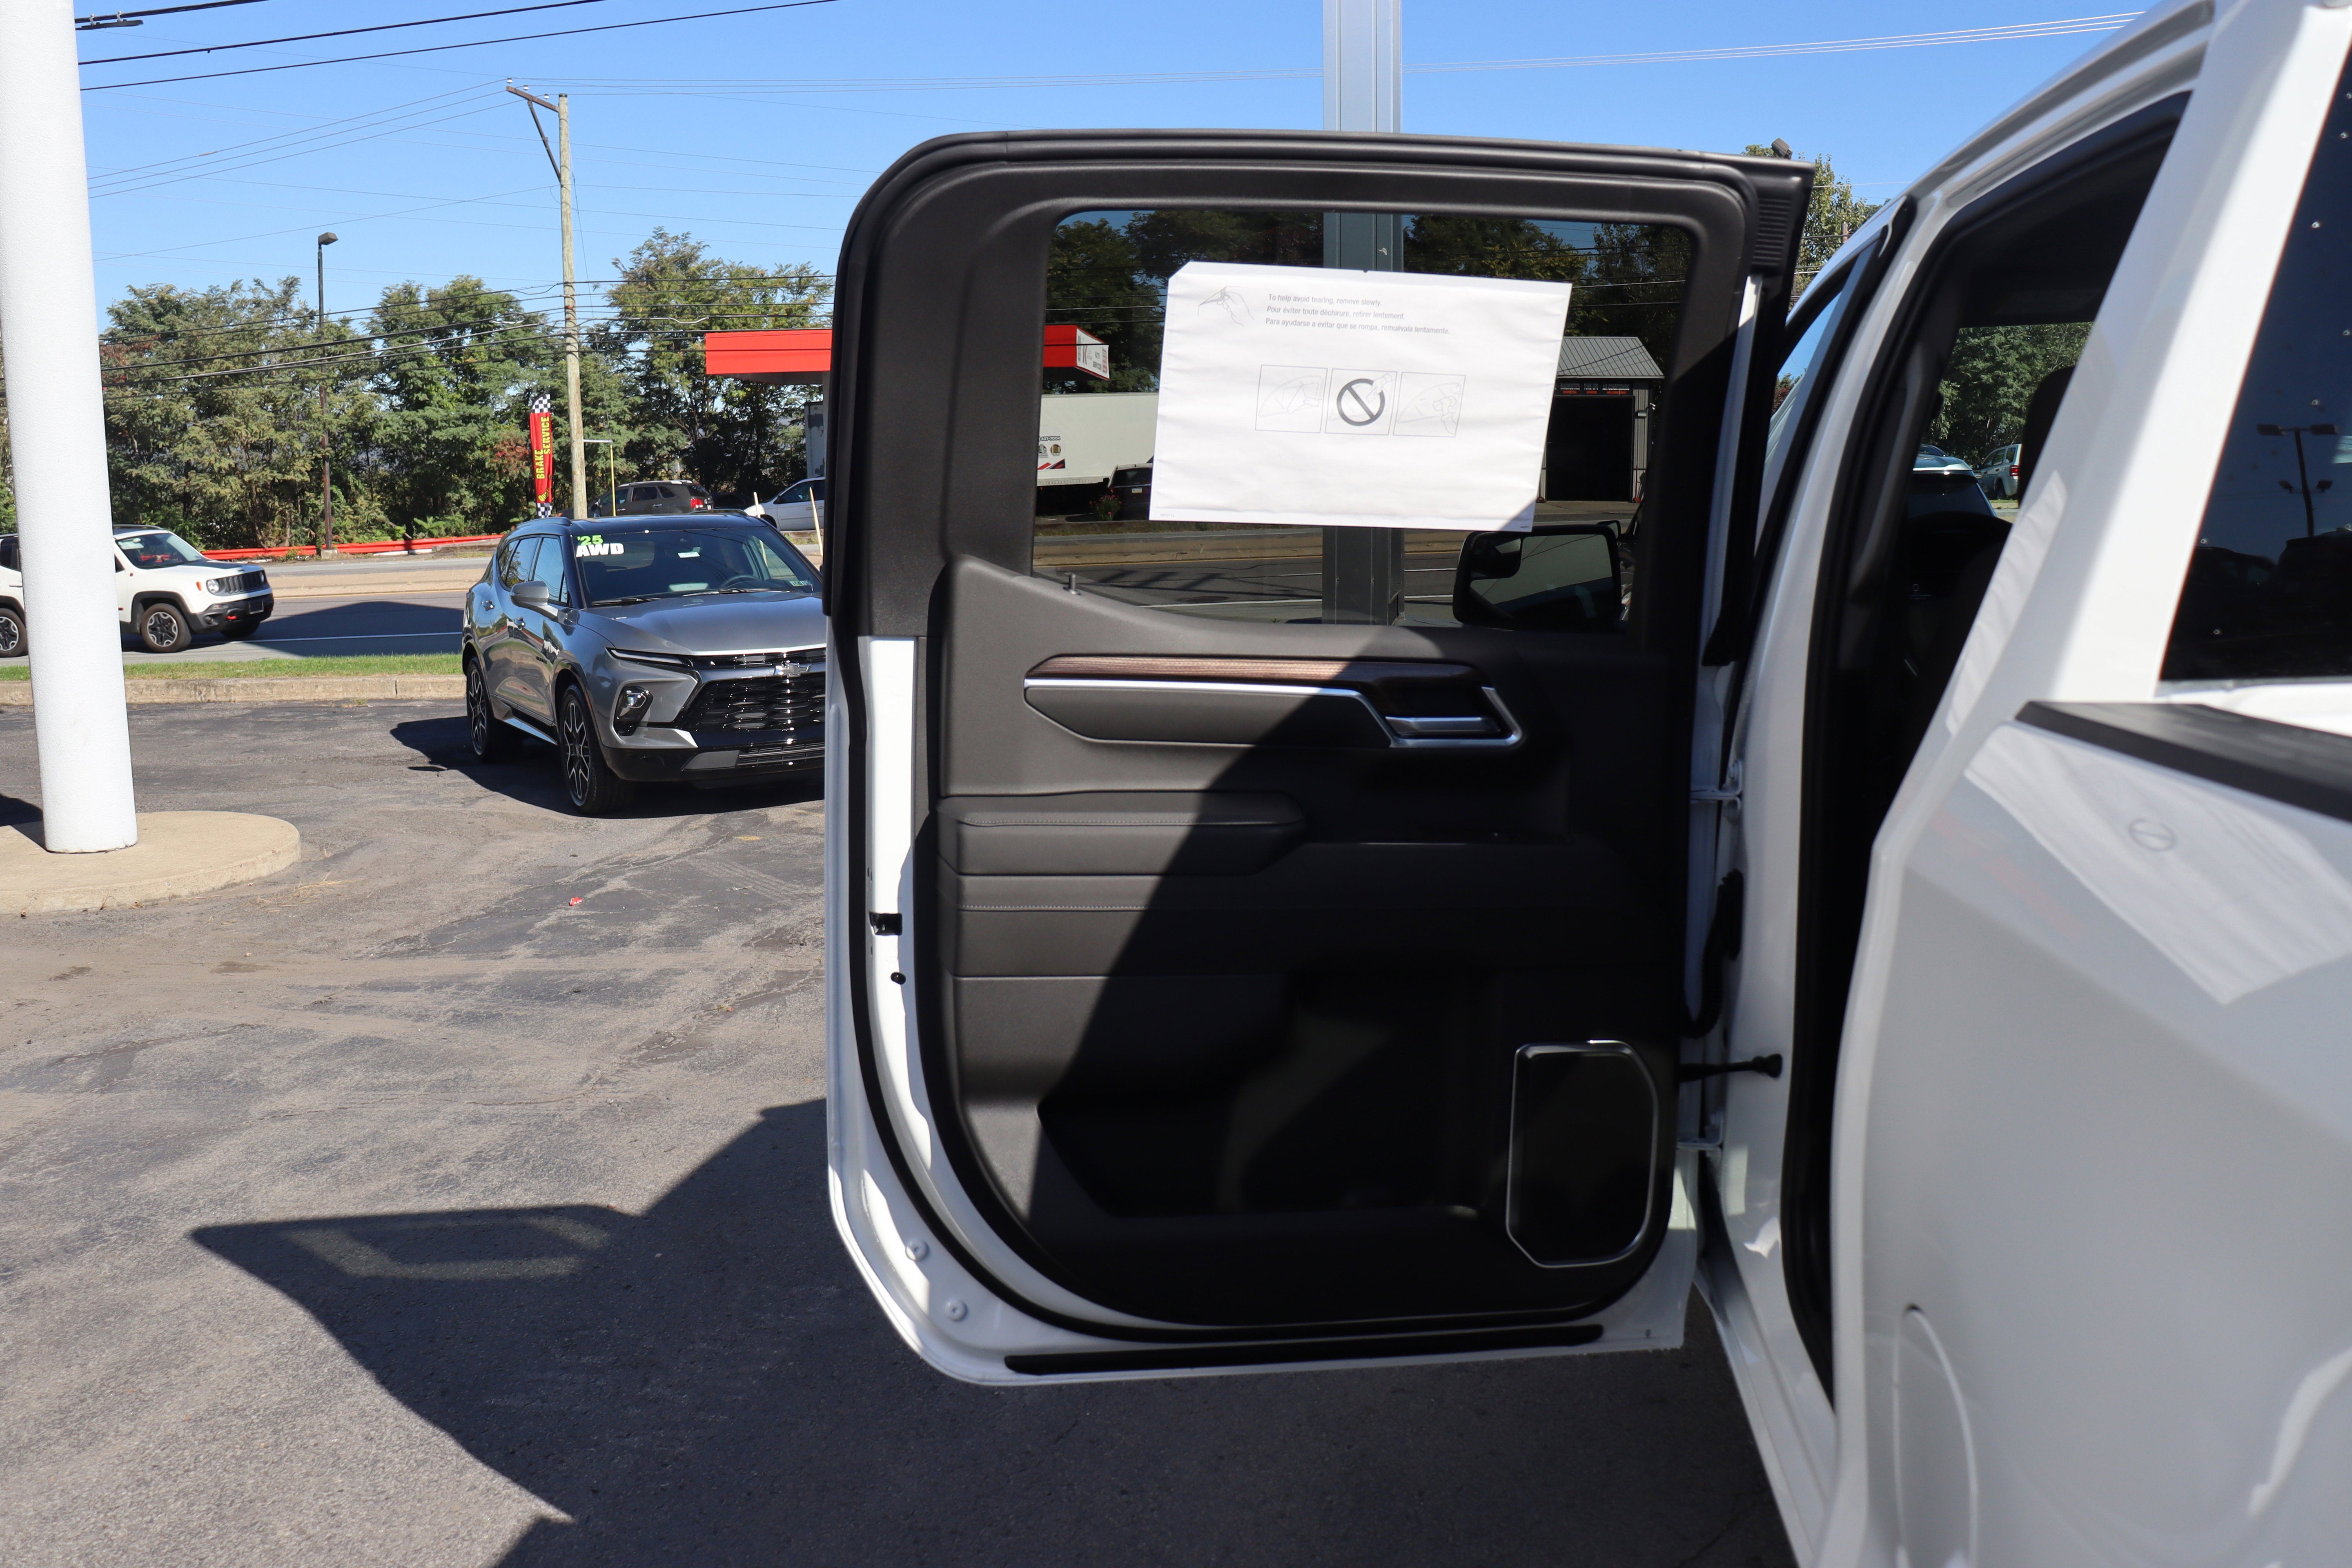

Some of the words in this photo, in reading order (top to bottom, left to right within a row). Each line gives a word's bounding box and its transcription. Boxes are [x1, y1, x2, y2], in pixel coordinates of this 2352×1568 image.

[1361, 299, 1382, 307] slowly.
[1320, 309, 1351, 318] déchirure,
[1373, 312, 1405, 320] lentement.
[1414, 326, 1450, 334] lentamente.
[540, 416, 550, 455] SERVICE
[534, 449, 545, 479] BRAKE
[576, 543, 624, 557] AWD
